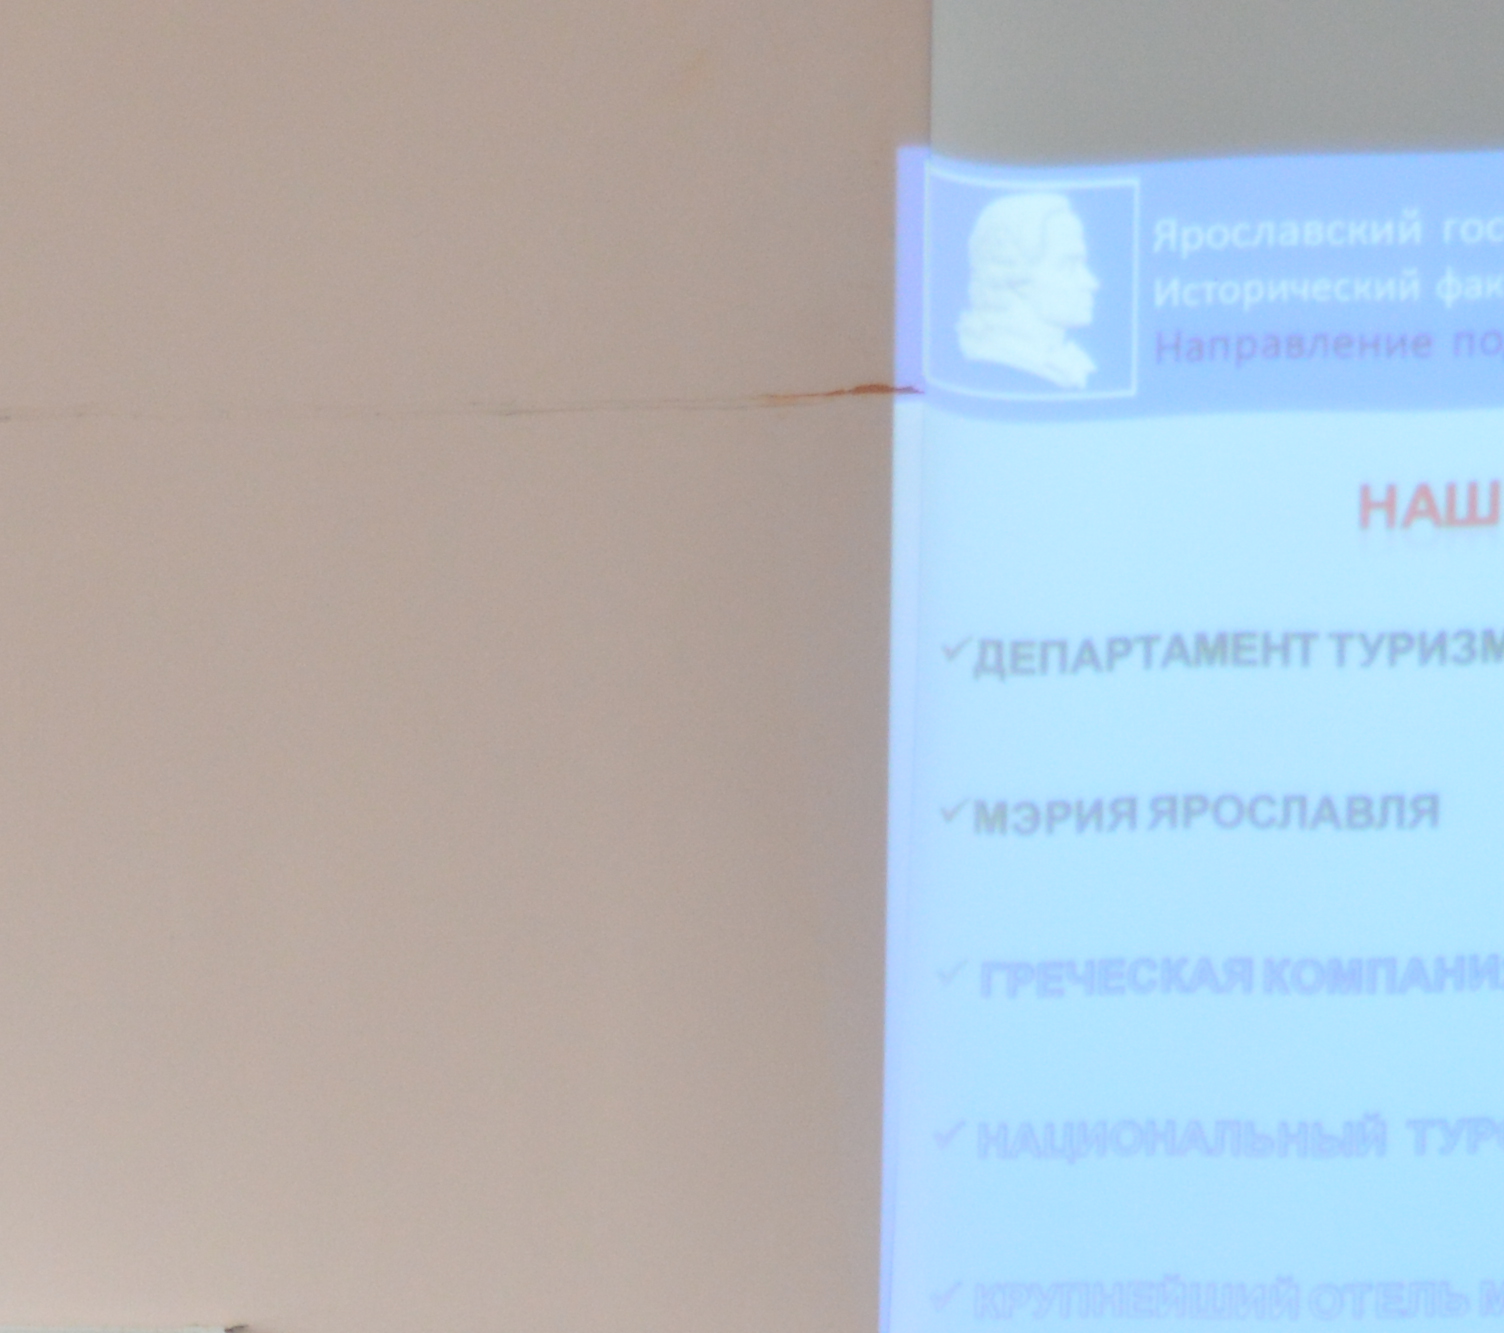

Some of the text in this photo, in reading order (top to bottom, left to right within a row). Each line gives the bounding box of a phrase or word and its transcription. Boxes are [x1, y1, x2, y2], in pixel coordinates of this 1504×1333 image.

[1152, 209, 1423, 258] Ярославский
[1152, 267, 1422, 311] Исторический
[1154, 329, 1434, 367] Направление
[973, 630, 1320, 680] ДЕПАРТАМЕНТ
[973, 792, 1441, 837] МЭРИЯ ЯРОСЛАВЛЯ
[979, 956, 1255, 999] ГРЕЧЕСКАЯ
[976, 1112, 1389, 1165] НАЦИОНАЛЬНЫЙ
[972, 1274, 1301, 1321] КРУПНЕЙШИЙ
[1307, 1279, 1470, 1321] ОТЕЛЬ
